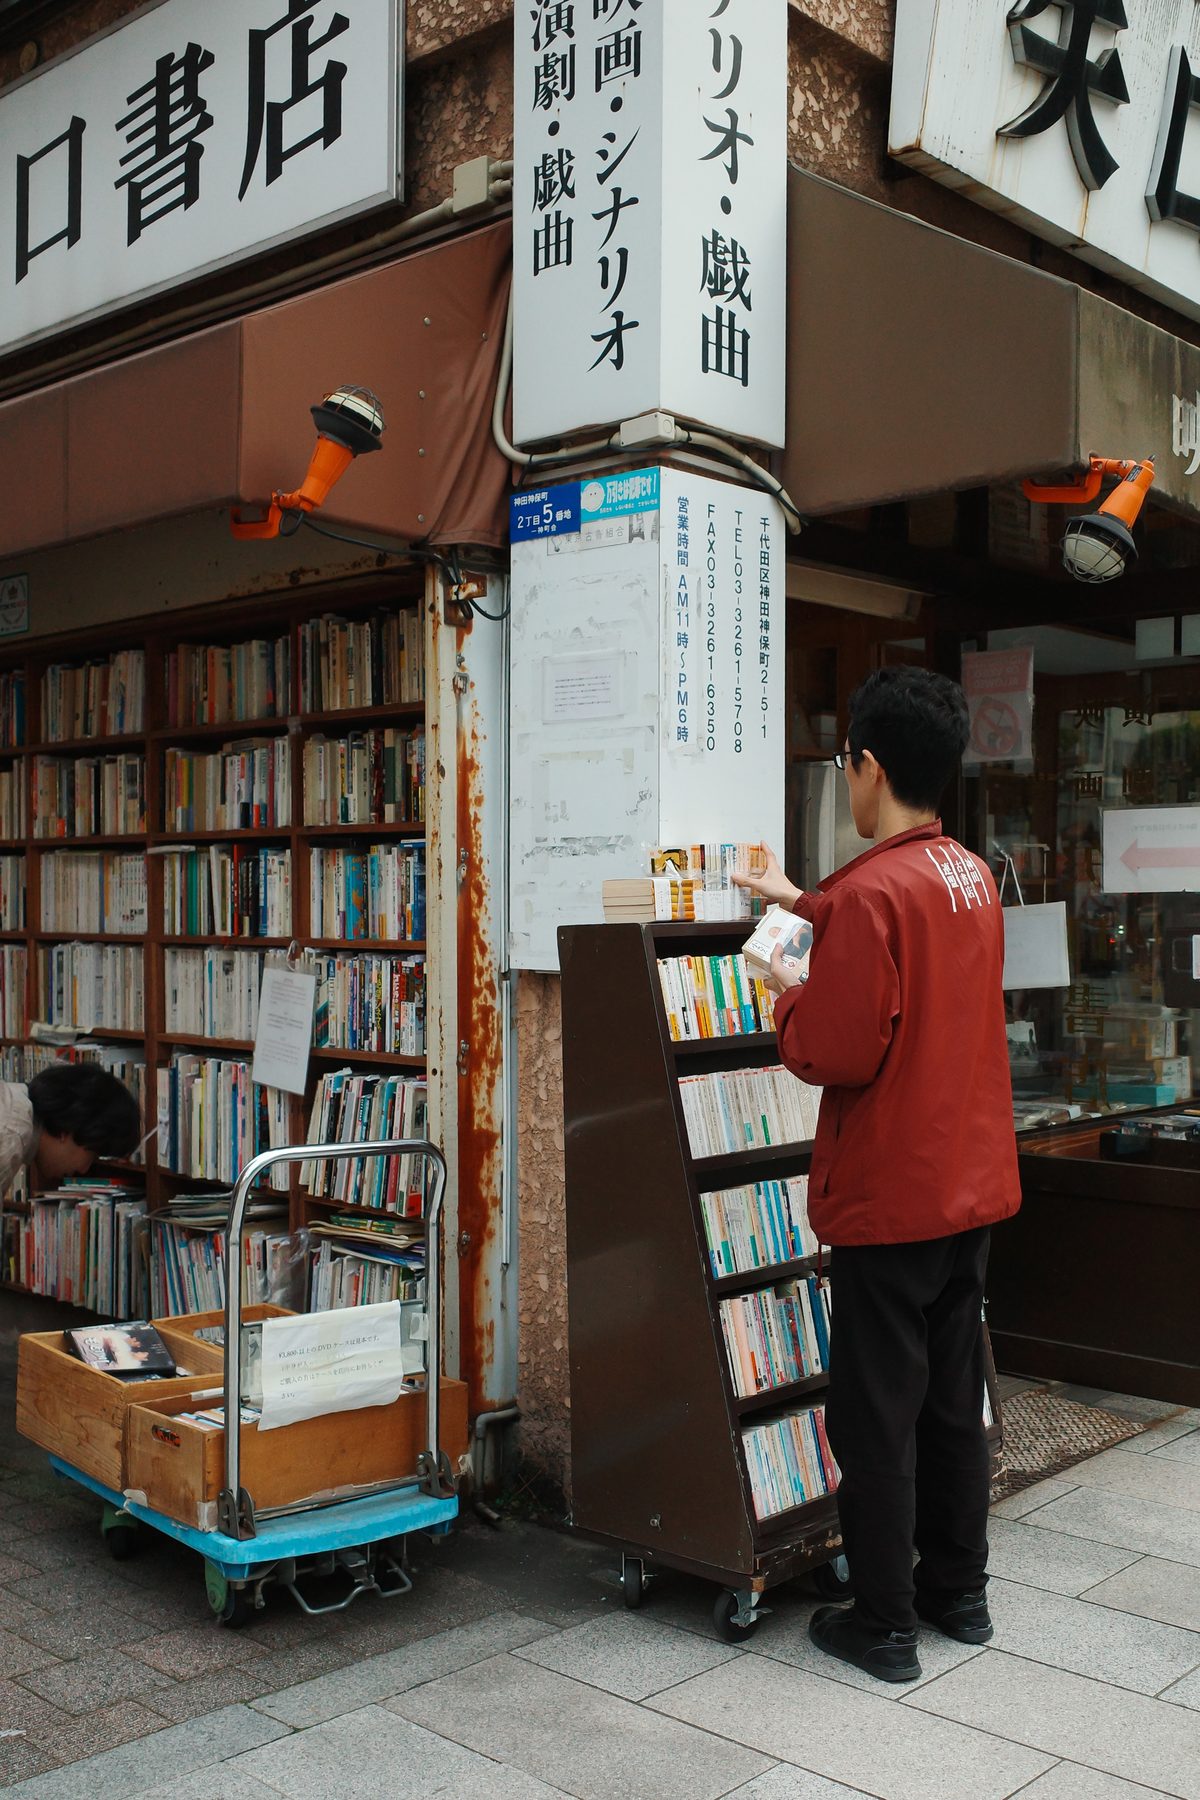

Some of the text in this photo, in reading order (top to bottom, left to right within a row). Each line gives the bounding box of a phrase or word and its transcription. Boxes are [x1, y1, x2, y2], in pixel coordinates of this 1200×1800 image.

[16, 0, 350, 285] 口書店
[530, 0, 576, 277] 演劇・戯曲
[697, 0, 755, 387] リオ・戯曲
[514, 491, 549, 506] 神田神保町
[677, 496, 689, 568] 営業時間
[759, 517, 771, 739] 千代田区神田神保町2-5-1
